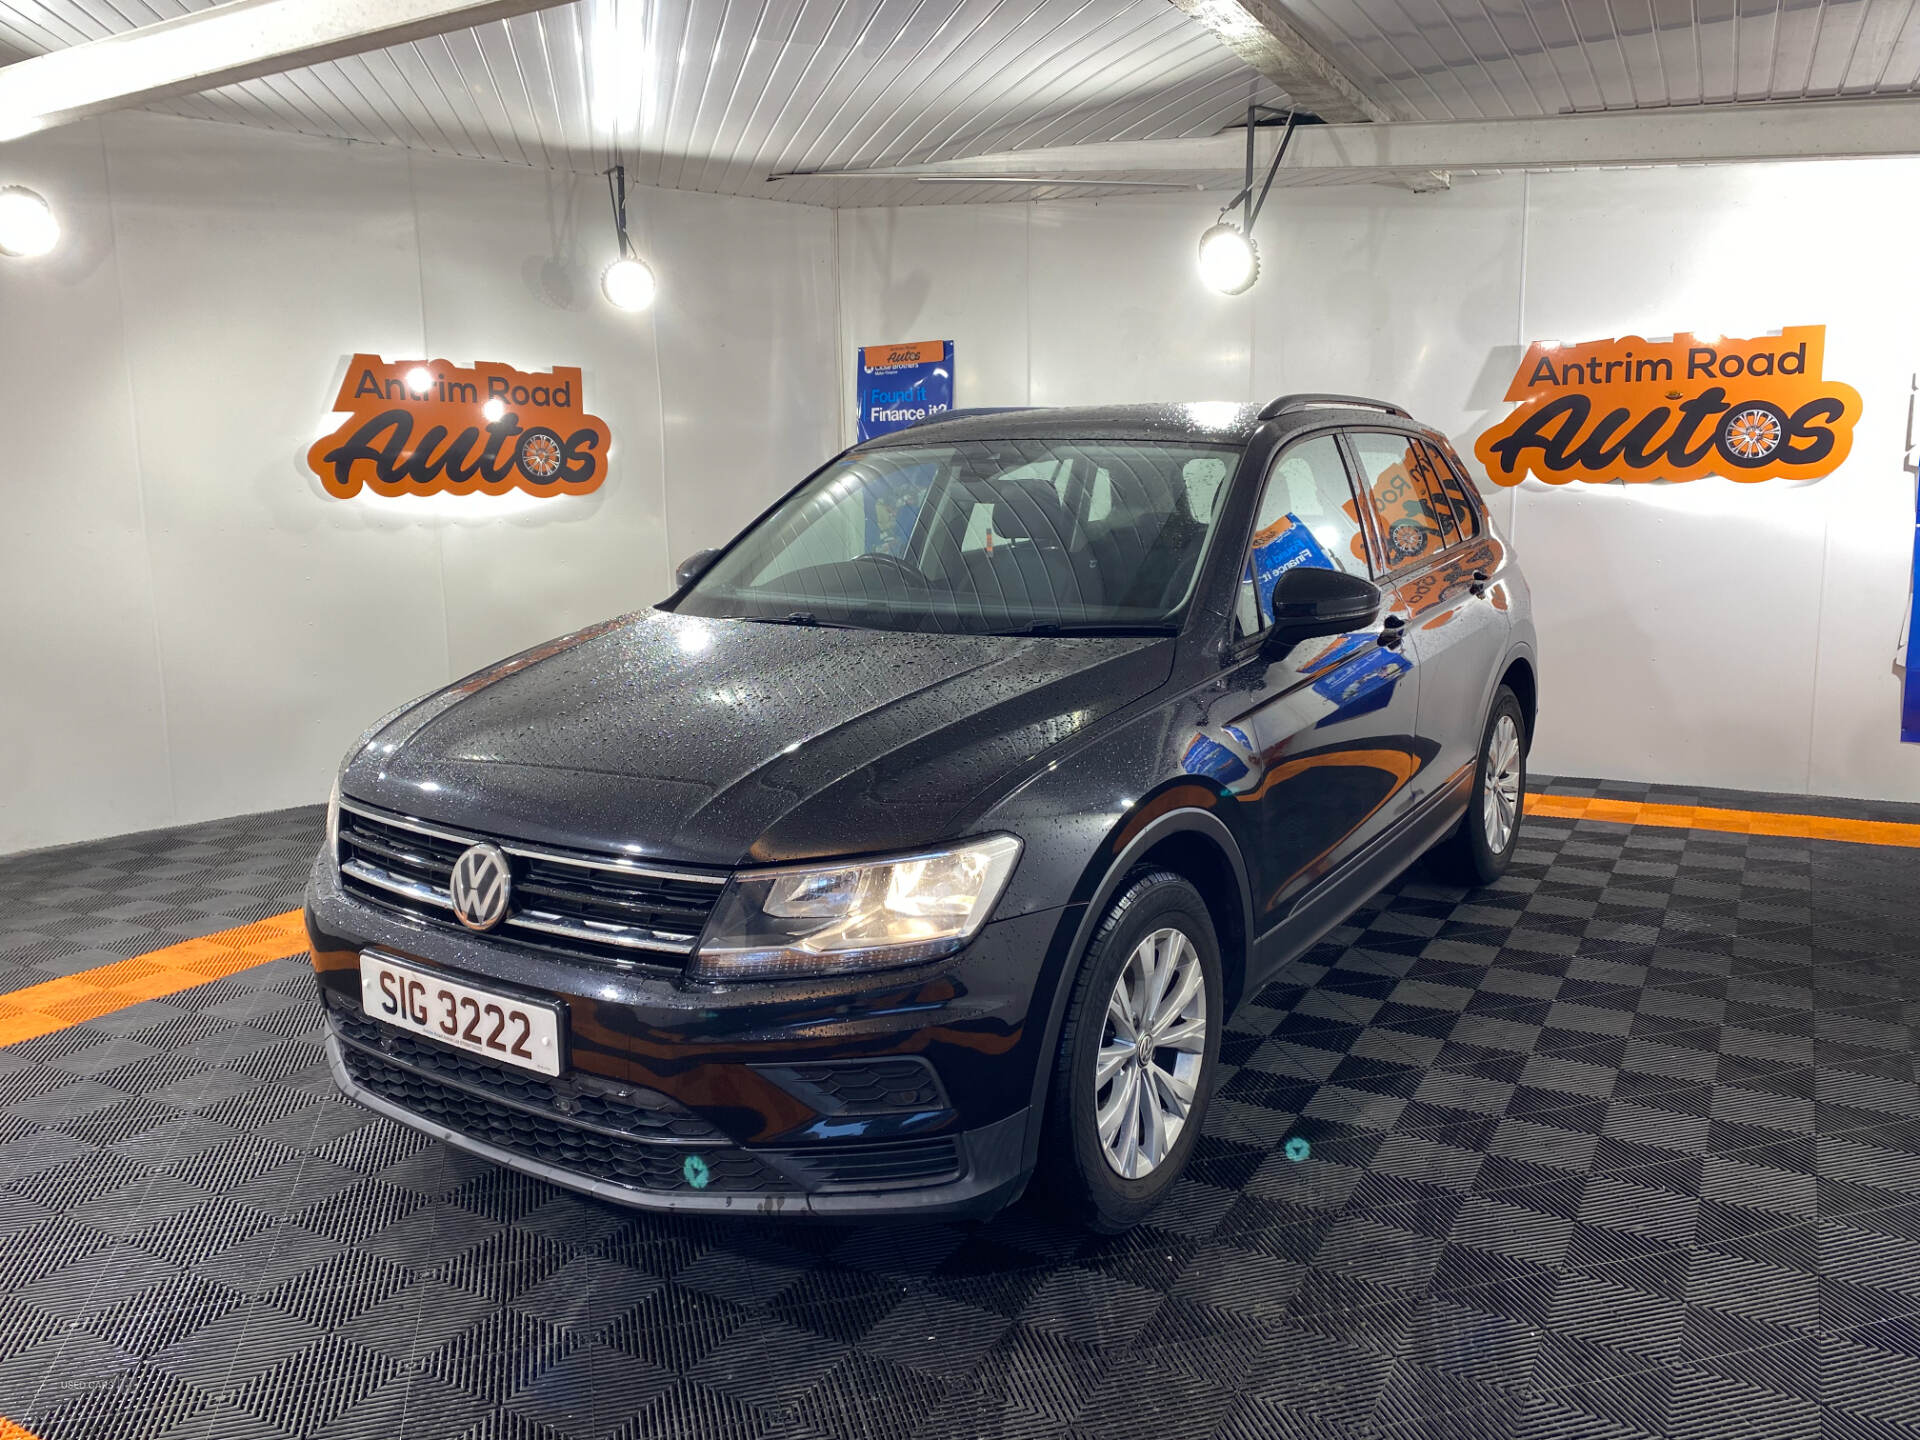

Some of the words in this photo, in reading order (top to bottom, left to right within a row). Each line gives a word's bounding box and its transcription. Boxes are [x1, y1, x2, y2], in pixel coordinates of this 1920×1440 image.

[1528, 352, 1673, 387] Antrim
[1688, 342, 1807, 379] Road
[487, 376, 571, 407] Road
[871, 387, 913, 404] Found
[917, 386, 928, 401] it
[871, 407, 926, 422] Finance
[1489, 386, 1846, 474] Autos
[323, 409, 600, 486] Autos
[379, 970, 428, 1026] SIG
[437, 989, 533, 1060] 3222
